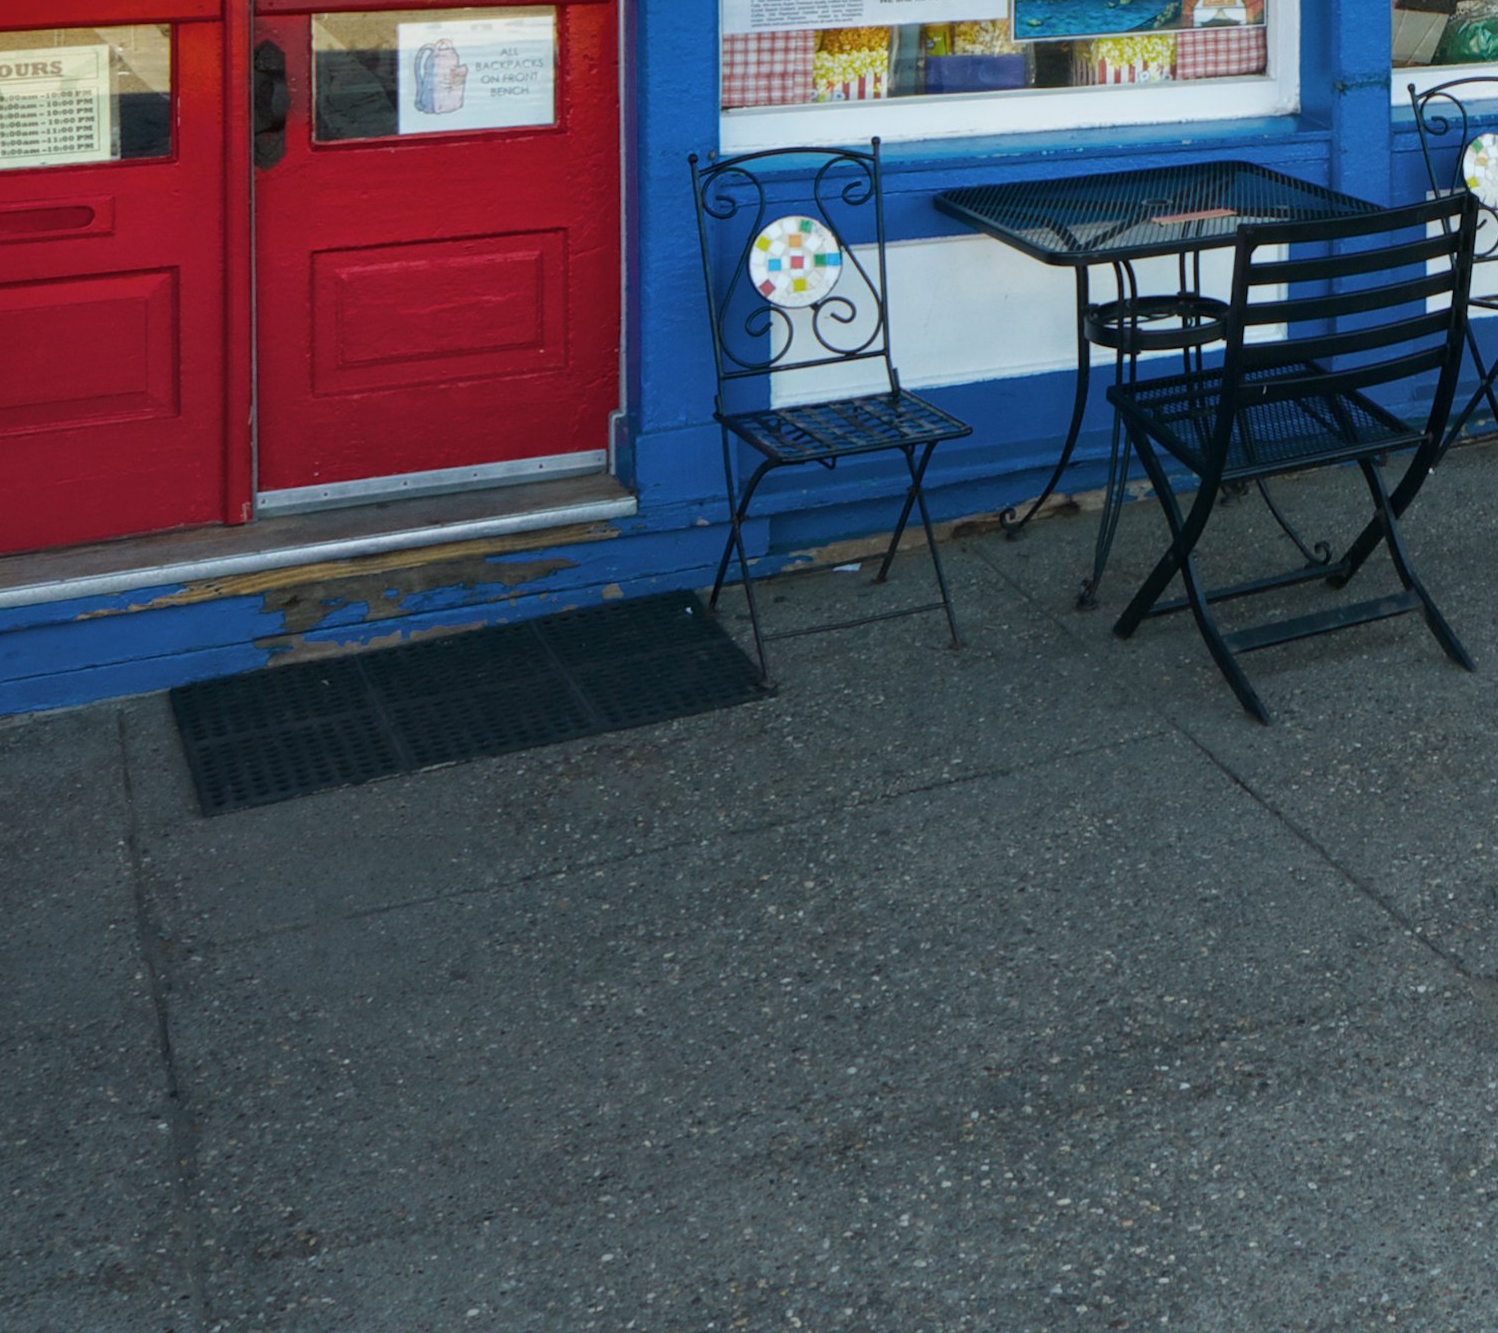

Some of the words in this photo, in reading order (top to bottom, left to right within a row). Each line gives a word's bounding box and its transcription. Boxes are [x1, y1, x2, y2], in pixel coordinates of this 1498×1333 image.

[501, 48, 519, 57] ALL
[475, 58, 544, 72] BACKPACKS
[480, 74, 500, 84] ON
[502, 72, 539, 82] FRONT
[75, 89, 92, 97] PM
[490, 87, 530, 97] BENCH
